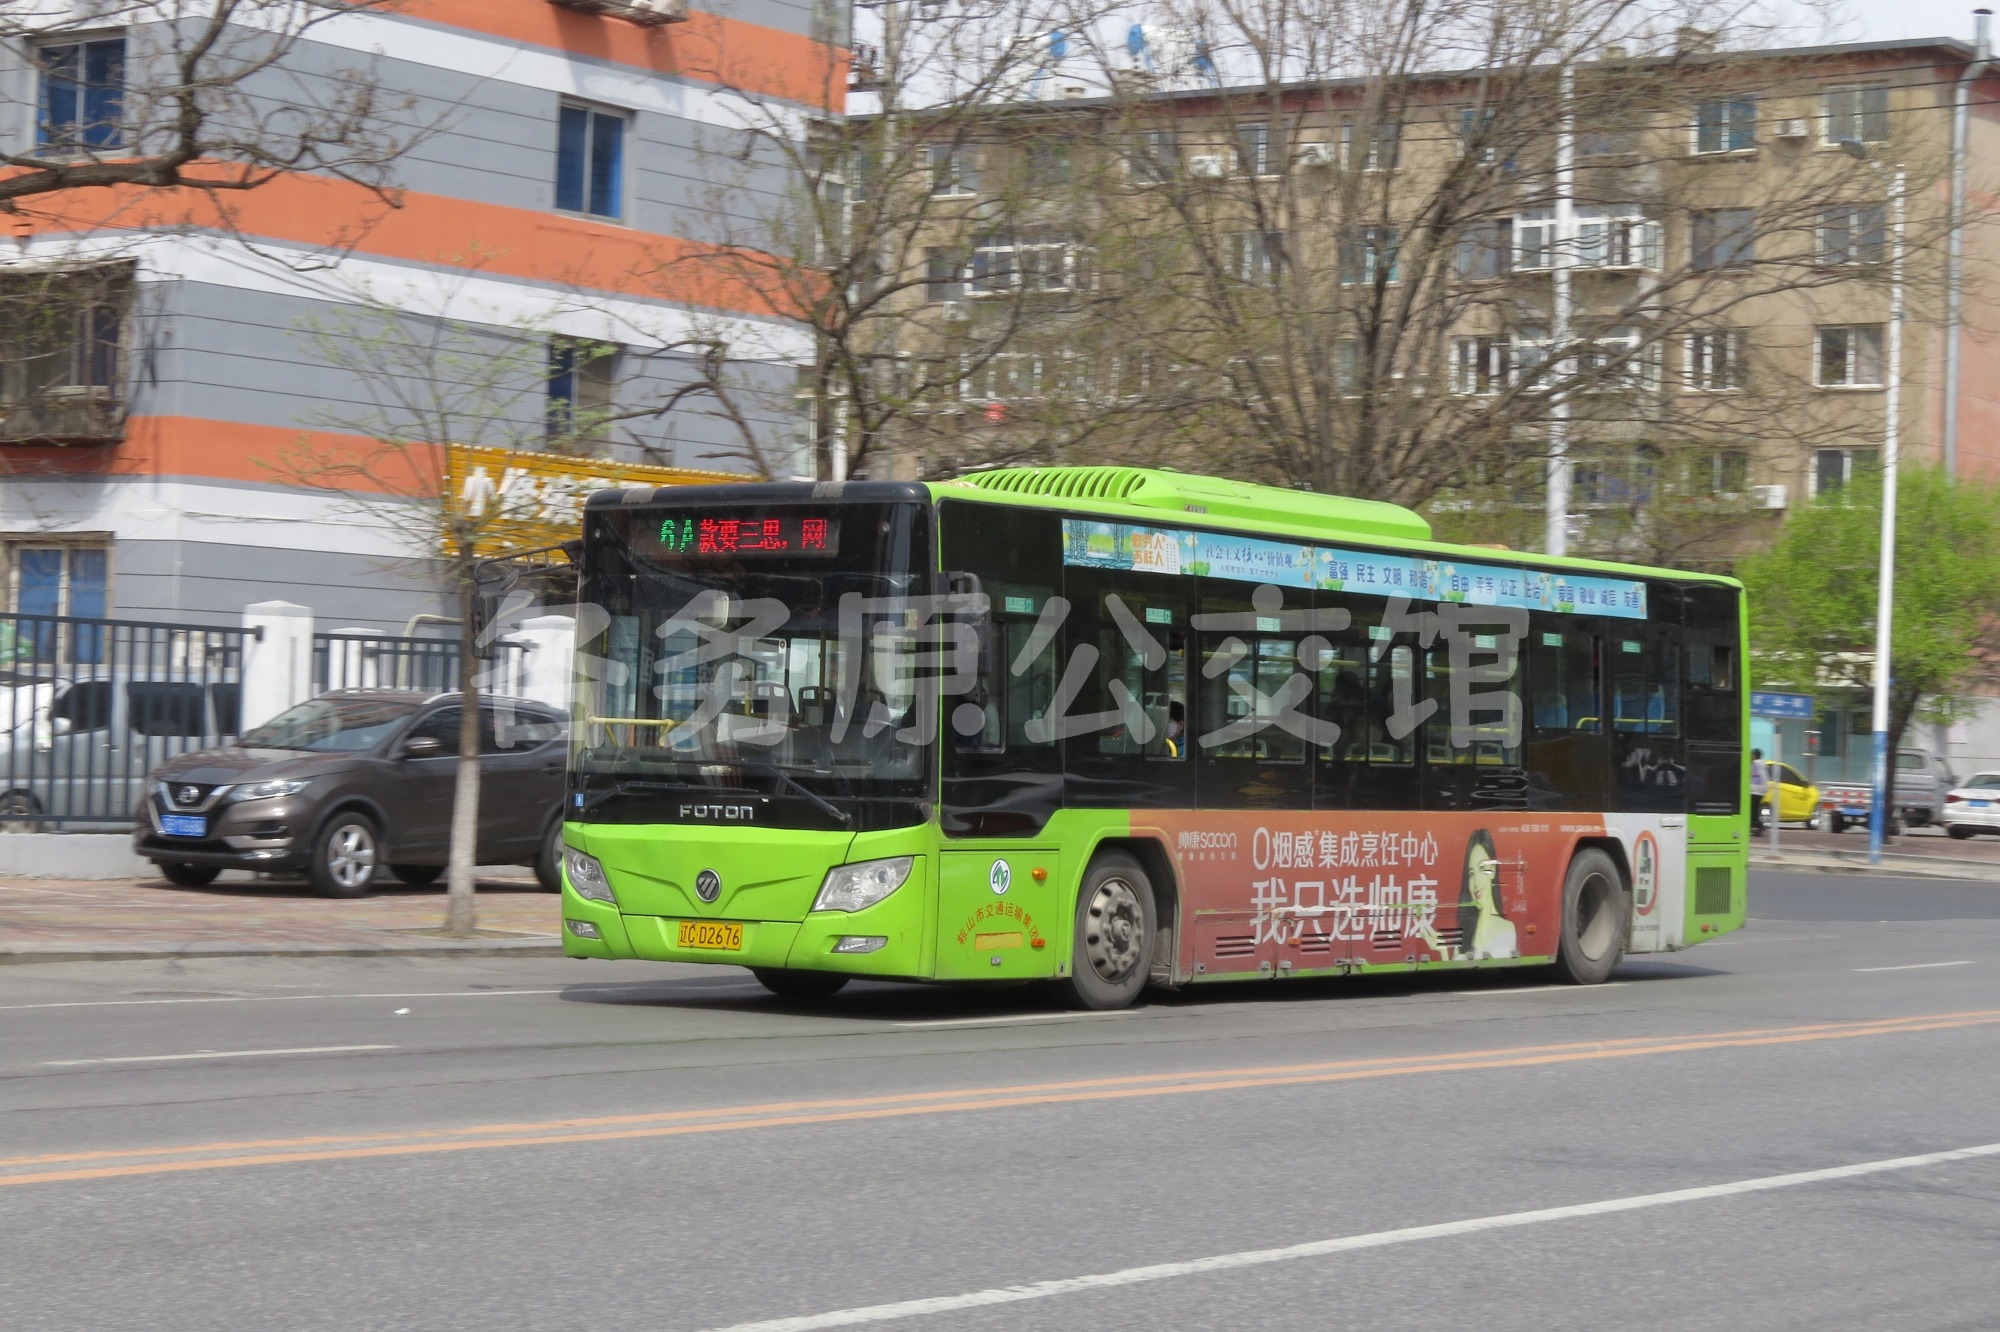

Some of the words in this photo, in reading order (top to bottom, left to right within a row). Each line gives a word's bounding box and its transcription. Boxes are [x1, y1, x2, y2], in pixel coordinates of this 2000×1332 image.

[1206, 543, 1293, 568] 社会主义核心价值观
[1329, 561, 1348, 580] 富强
[1356, 564, 1376, 583] 民主
[1383, 567, 1402, 585] 文明
[1452, 575, 1469, 592] 自由
[1476, 576, 1494, 595] 平等
[1500, 579, 1518, 596] 公正
[679, 804, 754, 820] FOTON
[1250, 874, 1439, 945] 我只选帅康
[957, 901, 1040, 945] 鞍山市交通运输集团
